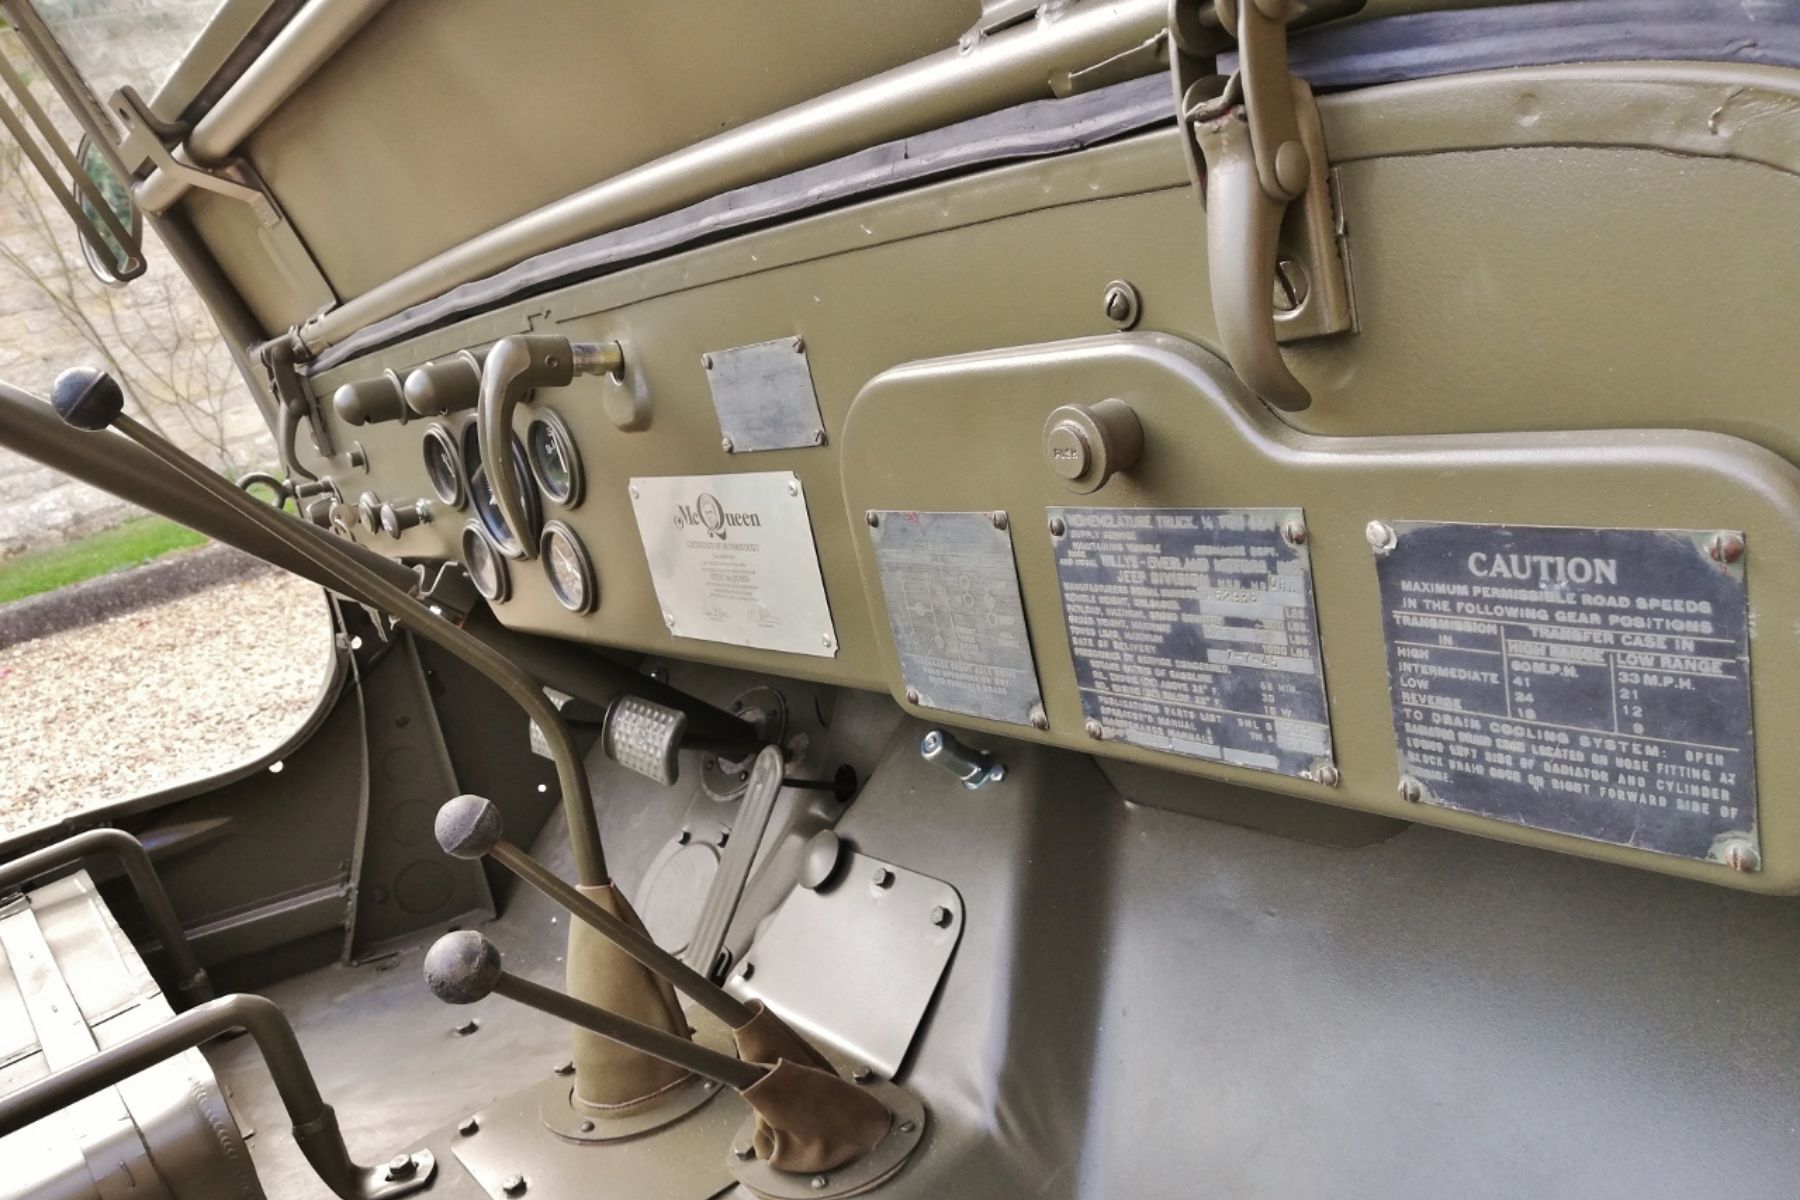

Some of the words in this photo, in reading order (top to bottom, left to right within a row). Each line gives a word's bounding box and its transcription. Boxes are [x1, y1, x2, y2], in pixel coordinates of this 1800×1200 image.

[673, 493, 761, 540] McQueen
[1468, 552, 1617, 584] CAUTION
[1401, 580, 1469, 596] MAXIMUM
[1472, 585, 1576, 604] PERMISSIBLE
[1581, 593, 1631, 608] ROAD
[1635, 597, 1712, 614] SPEEDS
[1393, 614, 1498, 635] TRANSMISSION
[1403, 598, 1417, 609] IN
[1423, 599, 1450, 611] THE
[1457, 602, 1549, 621] FOLLOWING
[1555, 610, 1601, 625] GEAR
[1609, 614, 1713, 634] POSITIONS
[1438, 635, 1453, 645] IN
[1507, 641, 1546, 656] HIGH
[1529, 625, 1615, 645] TRANSFER
[1621, 634, 1667, 649] CASE
[1675, 638, 1695, 652] IN
[1397, 647, 1429, 660] HIGH
[1616, 652, 1654, 667] LOW
[1661, 655, 1723, 673] RANGE
[1398, 661, 1500, 684] INTERMEDIATE
[1400, 677, 1429, 689] LOW
[1512, 676, 1530, 688] 41
[1402, 691, 1463, 710] REVERSE
[1514, 691, 1534, 703] 24
[1619, 688, 1638, 700] 21
[1622, 704, 1642, 718] 12
[1402, 708, 1424, 721] TO
[1432, 712, 1482, 730] DRAIN
[1489, 722, 1569, 744] COOLING
[1579, 735, 1667, 758] SYSTEM:
[1685, 750, 1725, 767] OPEN
[1531, 744, 1585, 762] LOCATED
[1591, 752, 1609, 766] ON
[1656, 763, 1711, 782] FITTING
[1519, 757, 1535, 770] OF
[1544, 761, 1609, 783] RADIATOR
[1618, 773, 1646, 787] AND
[1656, 779, 1731, 802] CYLINDER
[1552, 778, 1590, 794] RIGHT
[1600, 786, 1667, 807] FORWARD
[1676, 798, 1710, 815] SIDE
[1719, 806, 1738, 819] OF
